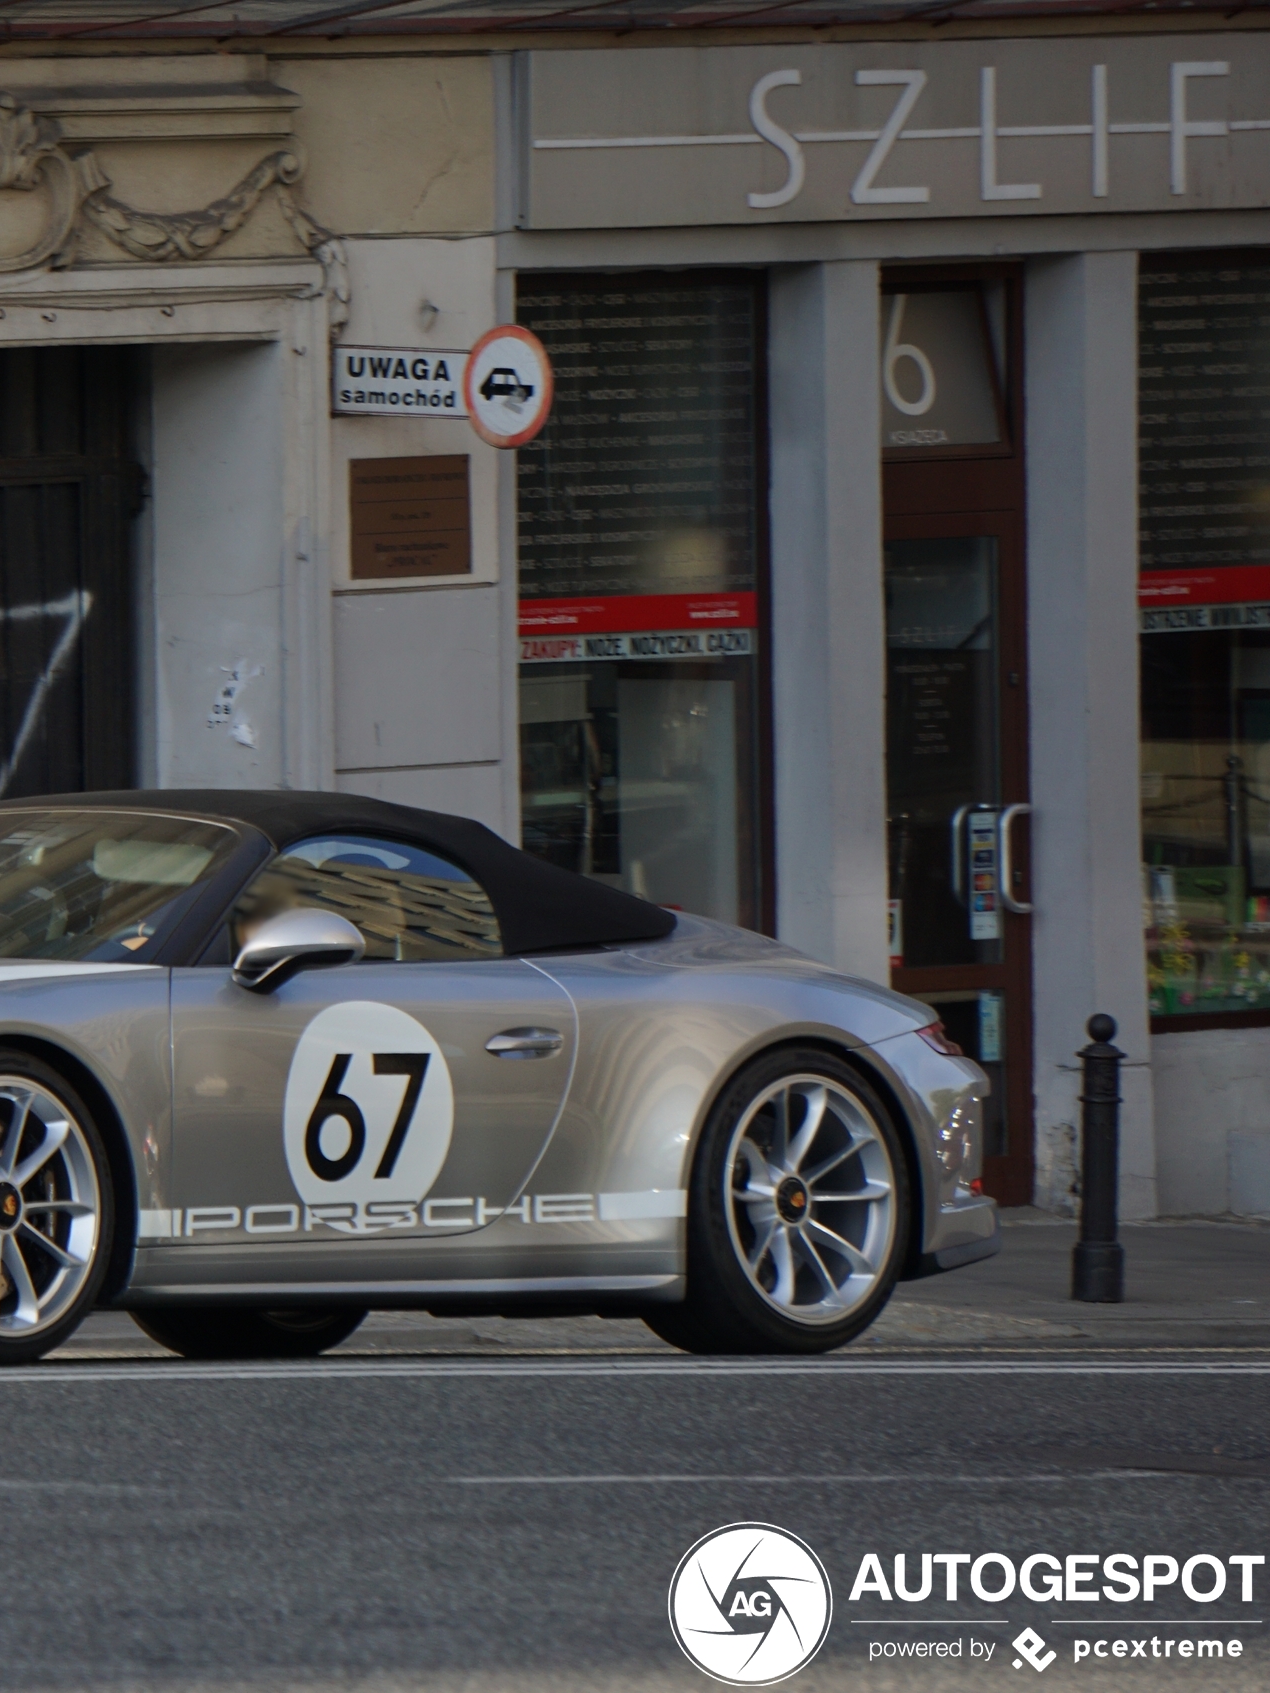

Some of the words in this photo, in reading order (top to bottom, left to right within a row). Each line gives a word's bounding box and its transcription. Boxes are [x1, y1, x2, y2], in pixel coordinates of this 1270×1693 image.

[747, 62, 1229, 209] SZLIF
[347, 356, 451, 382] UWAGA
[884, 294, 936, 416] 6
[339, 388, 457, 409] samochód
[521, 640, 581, 660] ZAKUPY:
[304, 1053, 431, 1183] 67
[184, 1194, 596, 1238] PORSCHE
